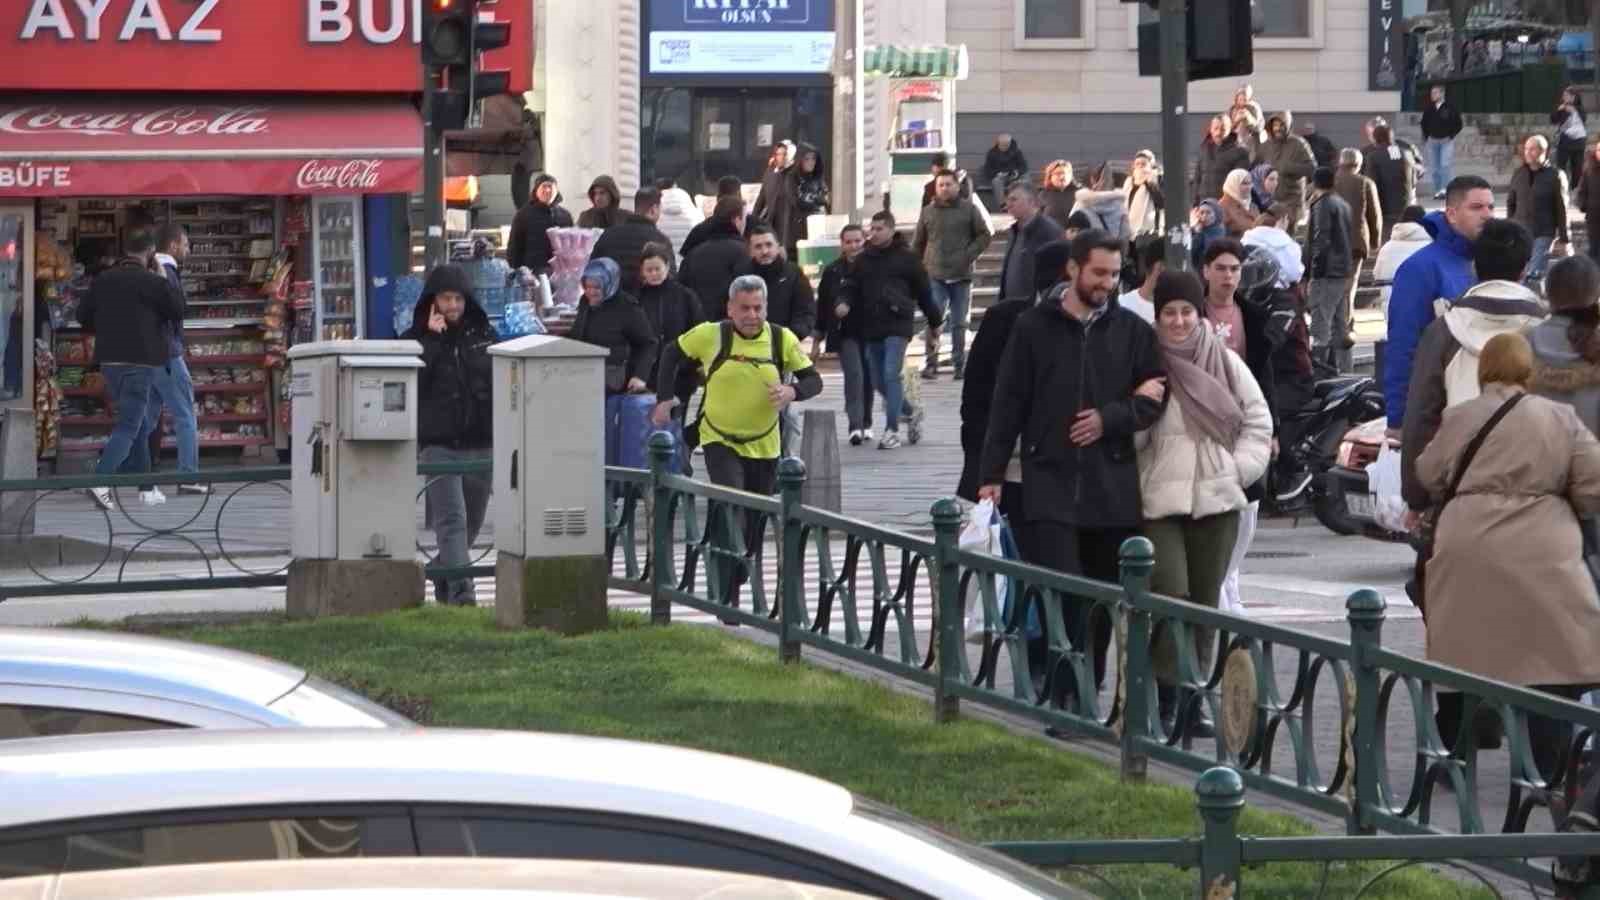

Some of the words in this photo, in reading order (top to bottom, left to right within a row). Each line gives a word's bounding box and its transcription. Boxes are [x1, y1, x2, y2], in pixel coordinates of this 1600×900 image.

[19, 0, 223, 41] AYAZ
[721, 9, 773, 24] OLSUN
[0, 162, 71, 187] BÜFE
[297, 159, 383, 189] Coca-Cola
